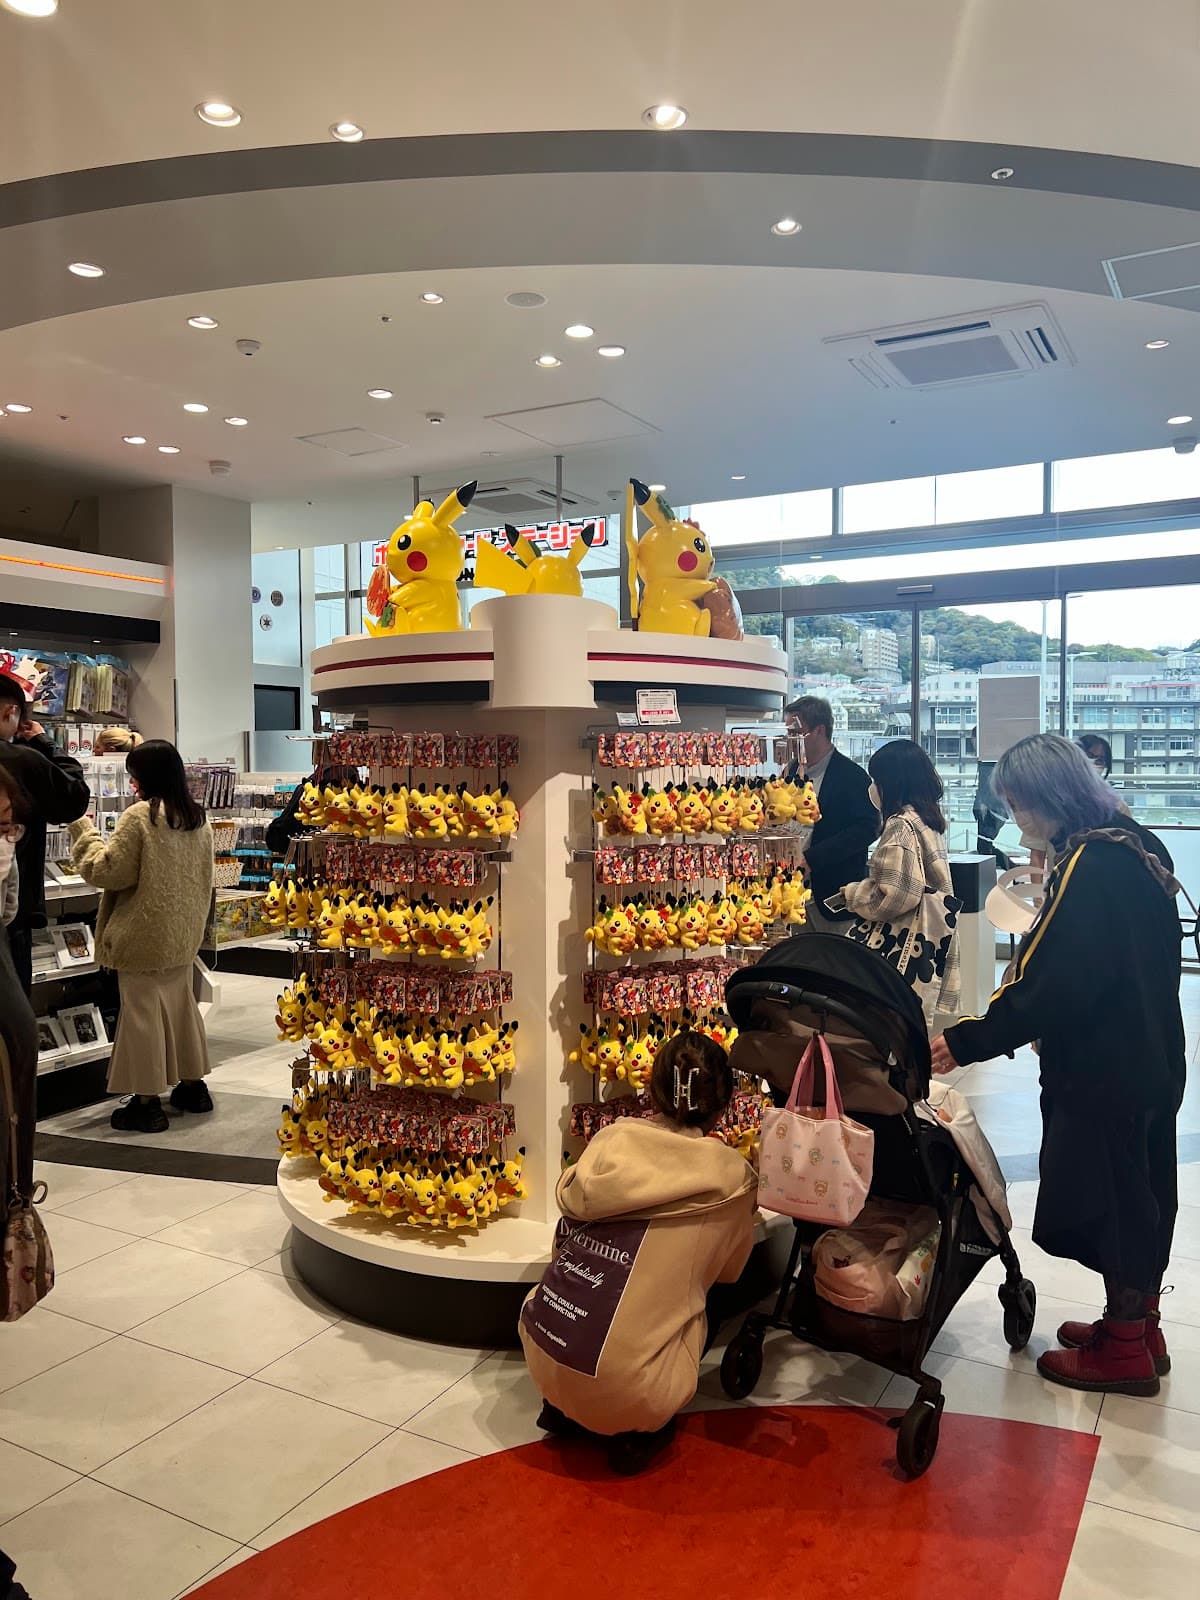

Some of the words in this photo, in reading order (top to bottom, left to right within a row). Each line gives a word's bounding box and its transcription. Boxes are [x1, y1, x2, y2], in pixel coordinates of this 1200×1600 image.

[556, 1248, 604, 1289] Emphatically
[558, 1295, 574, 1310] COULD
[574, 1305, 589, 1318] SWAY
